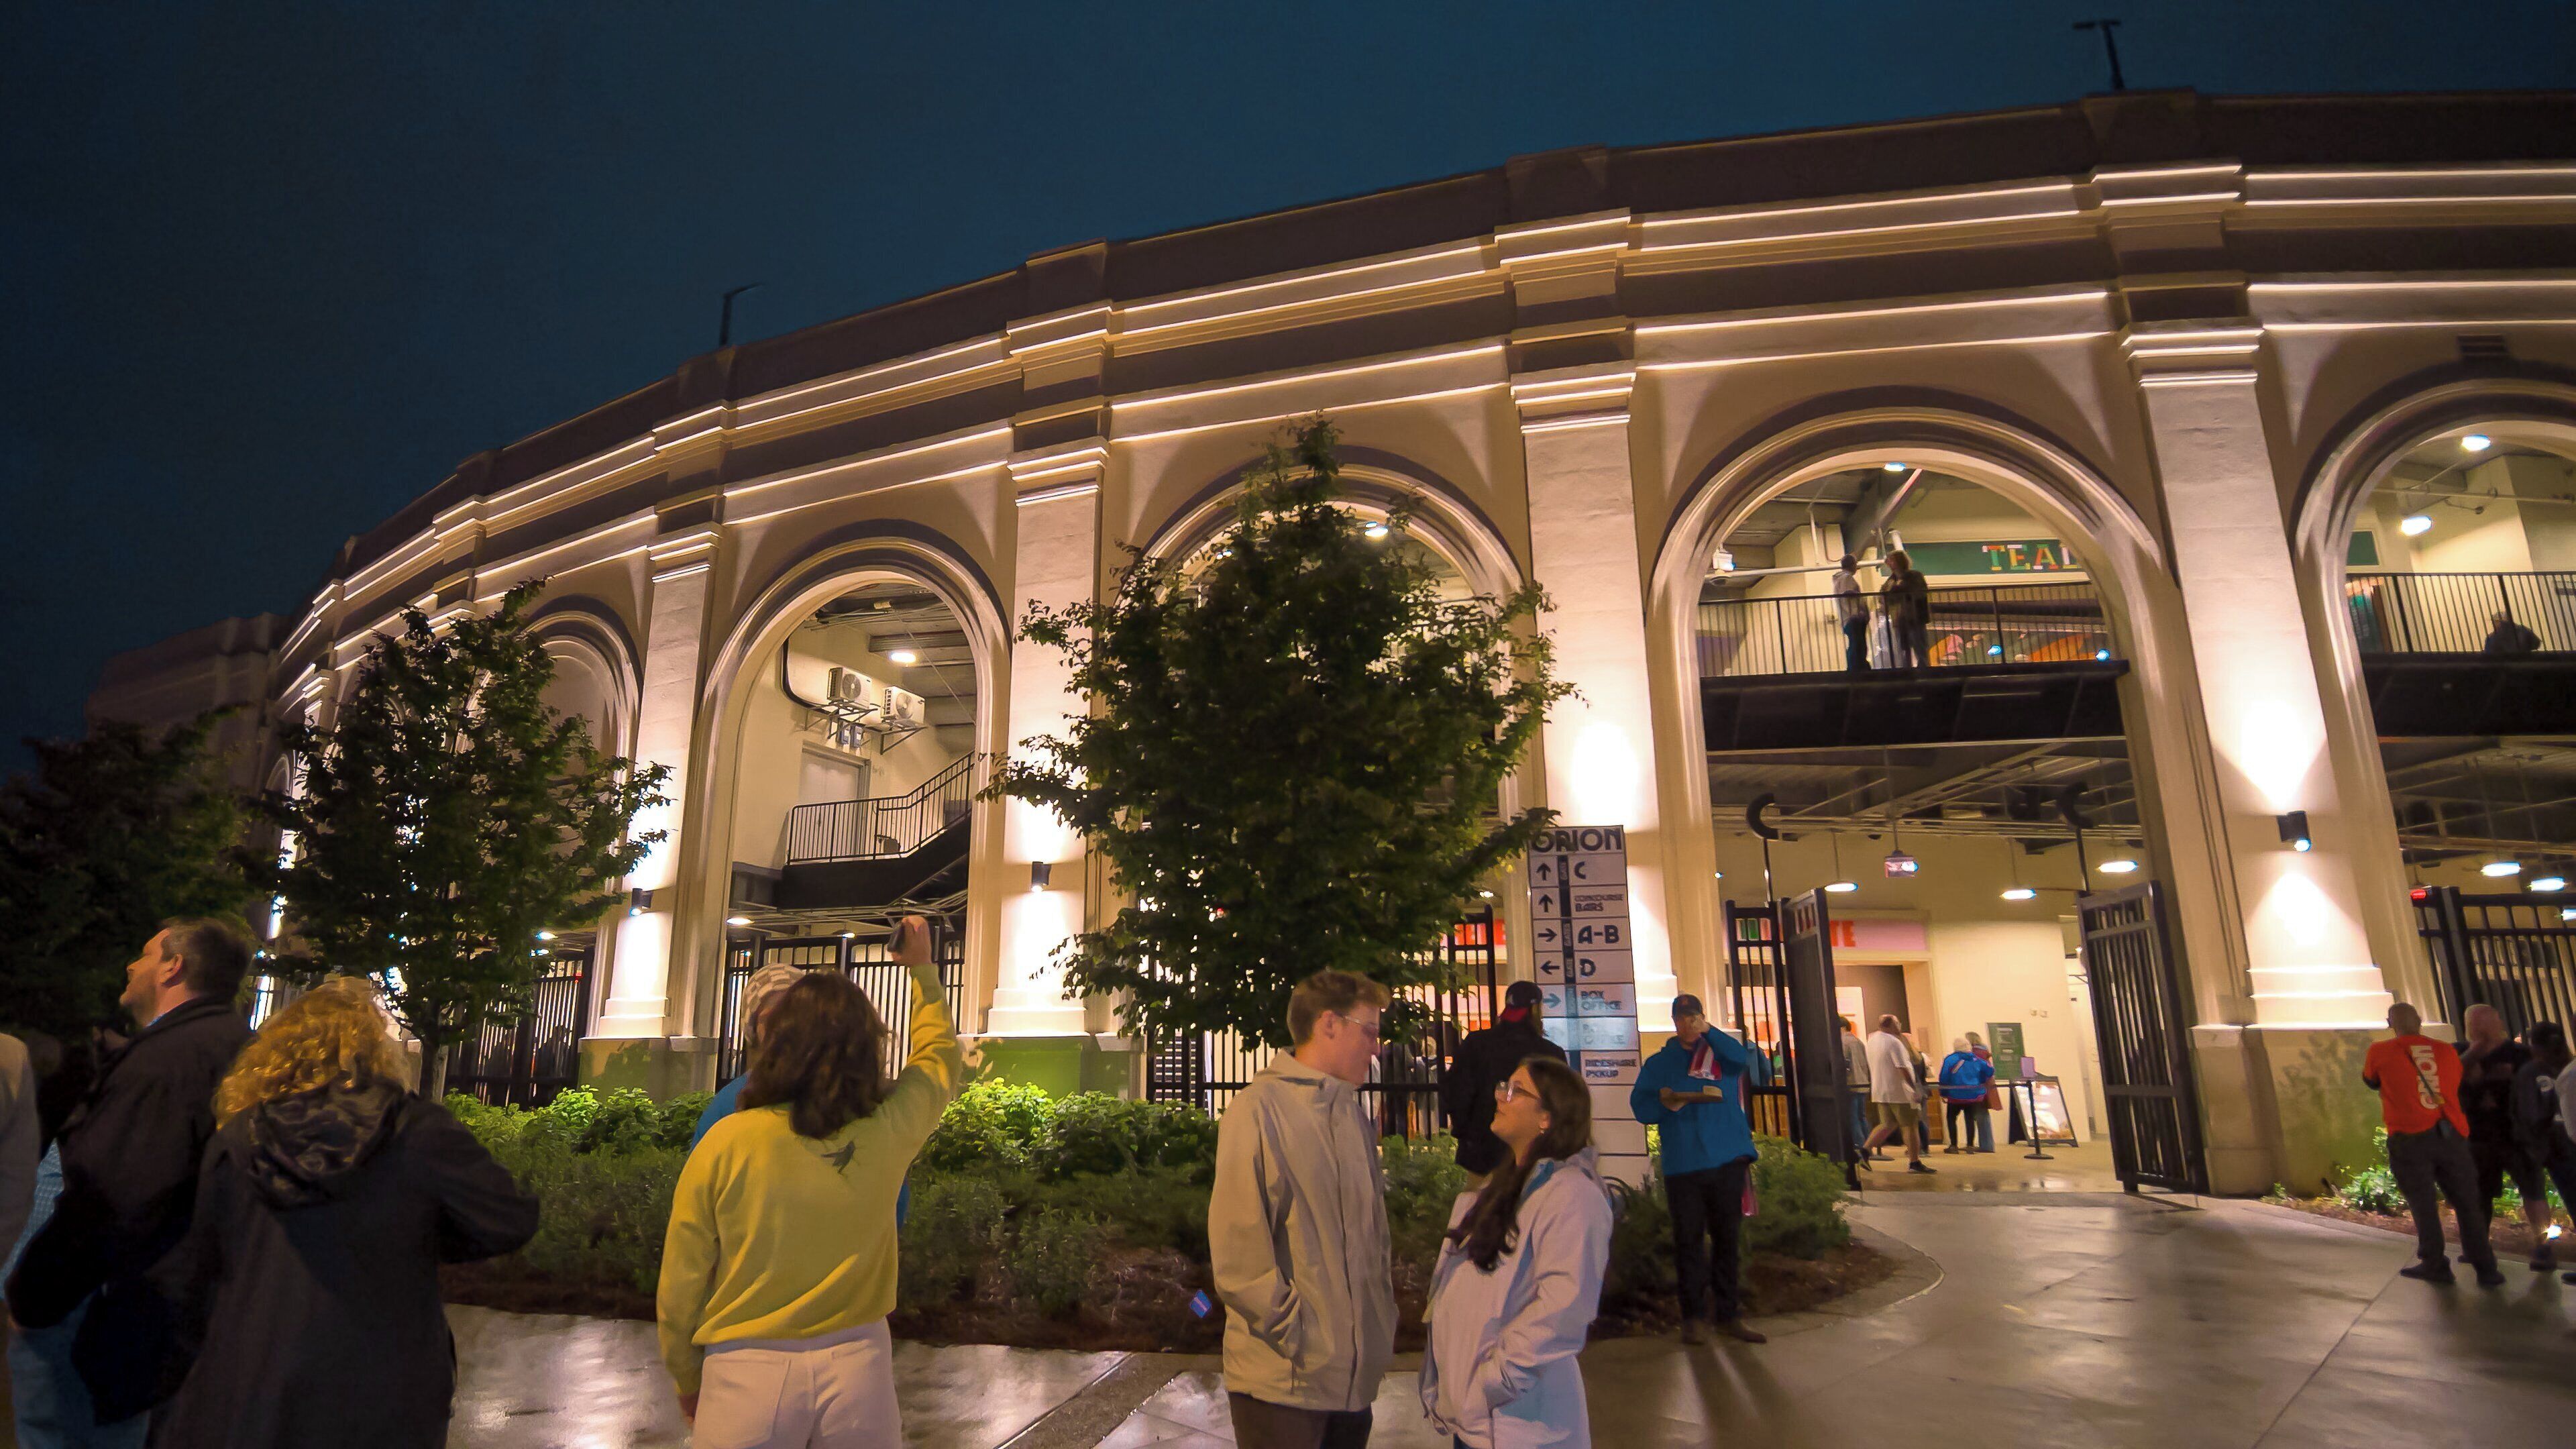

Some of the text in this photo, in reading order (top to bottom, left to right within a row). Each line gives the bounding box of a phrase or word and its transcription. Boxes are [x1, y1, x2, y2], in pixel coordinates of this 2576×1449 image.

[1532, 828, 1622, 853] ORION
[1574, 861, 1587, 879] C
[1575, 902, 1604, 912] BARS
[1578, 924, 1619, 945] A-B
[1579, 958, 1597, 977] D
[1580, 991, 1604, 1000] BOX
[1582, 1000, 1622, 1010] OFFICE
[1585, 1069, 1619, 1079] PICKUP
